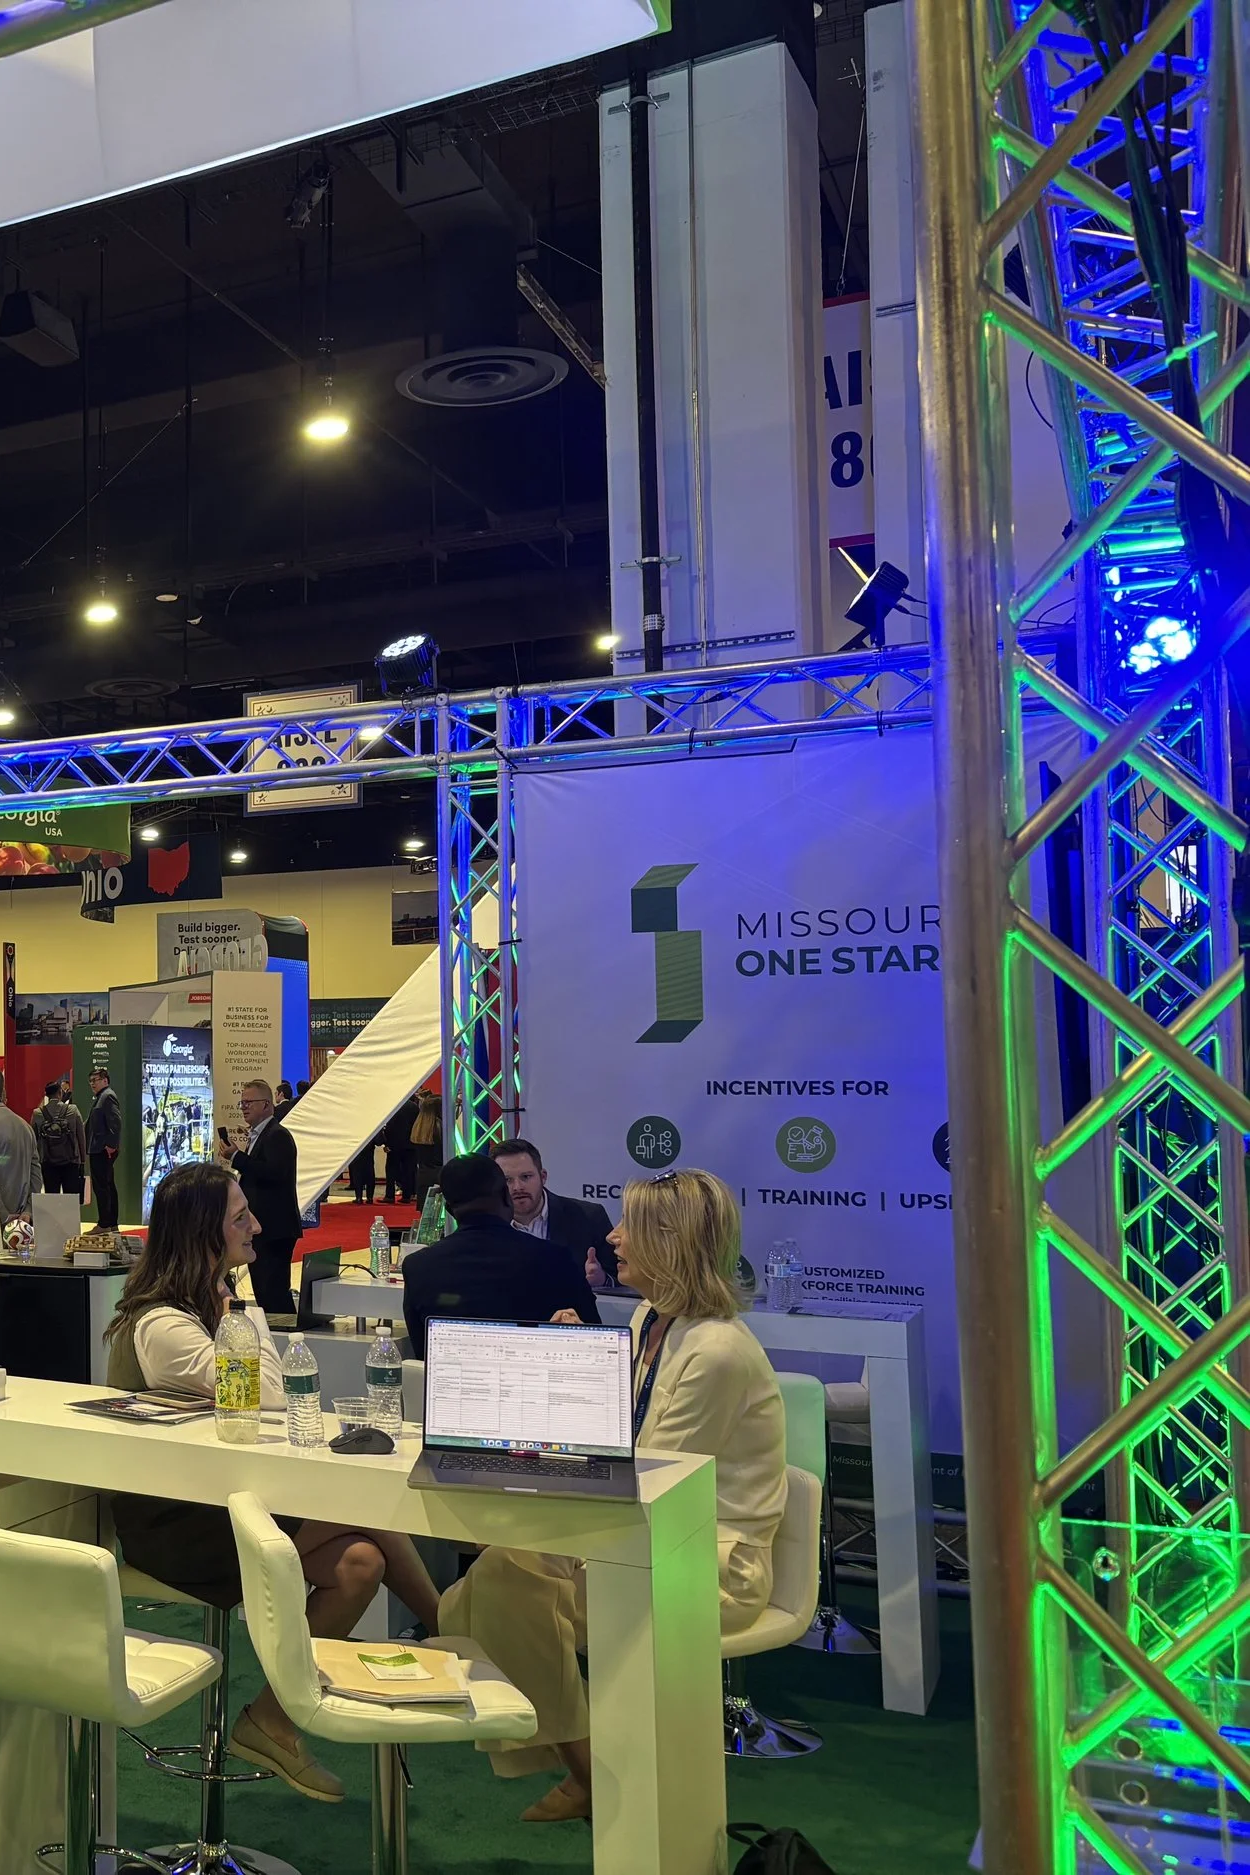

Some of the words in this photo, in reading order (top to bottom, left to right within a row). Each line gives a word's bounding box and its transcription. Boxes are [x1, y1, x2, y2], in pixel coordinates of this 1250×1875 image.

[830, 431, 874, 488] 8
[45, 827, 63, 837] USA
[178, 923, 202, 932] Build
[205, 922, 241, 934] bigger.
[179, 935, 199, 944] Test
[202, 936, 240, 944] sooner.
[735, 948, 822, 977] ONE
[333, 1018, 350, 1026] Test
[146, 1064, 169, 1073] STRONG
[150, 1077, 168, 1086] GREAT
[706, 1080, 836, 1096] INCENTIVES
[842, 1080, 889, 1096] FOR
[758, 1188, 867, 1207] TRAINING
[899, 1193, 953, 1210] UPS
[804, 1266, 885, 1280] USTOMIZED
[801, 1280, 853, 1293] KFORCE
[856, 1283, 925, 1297] TRAINING
